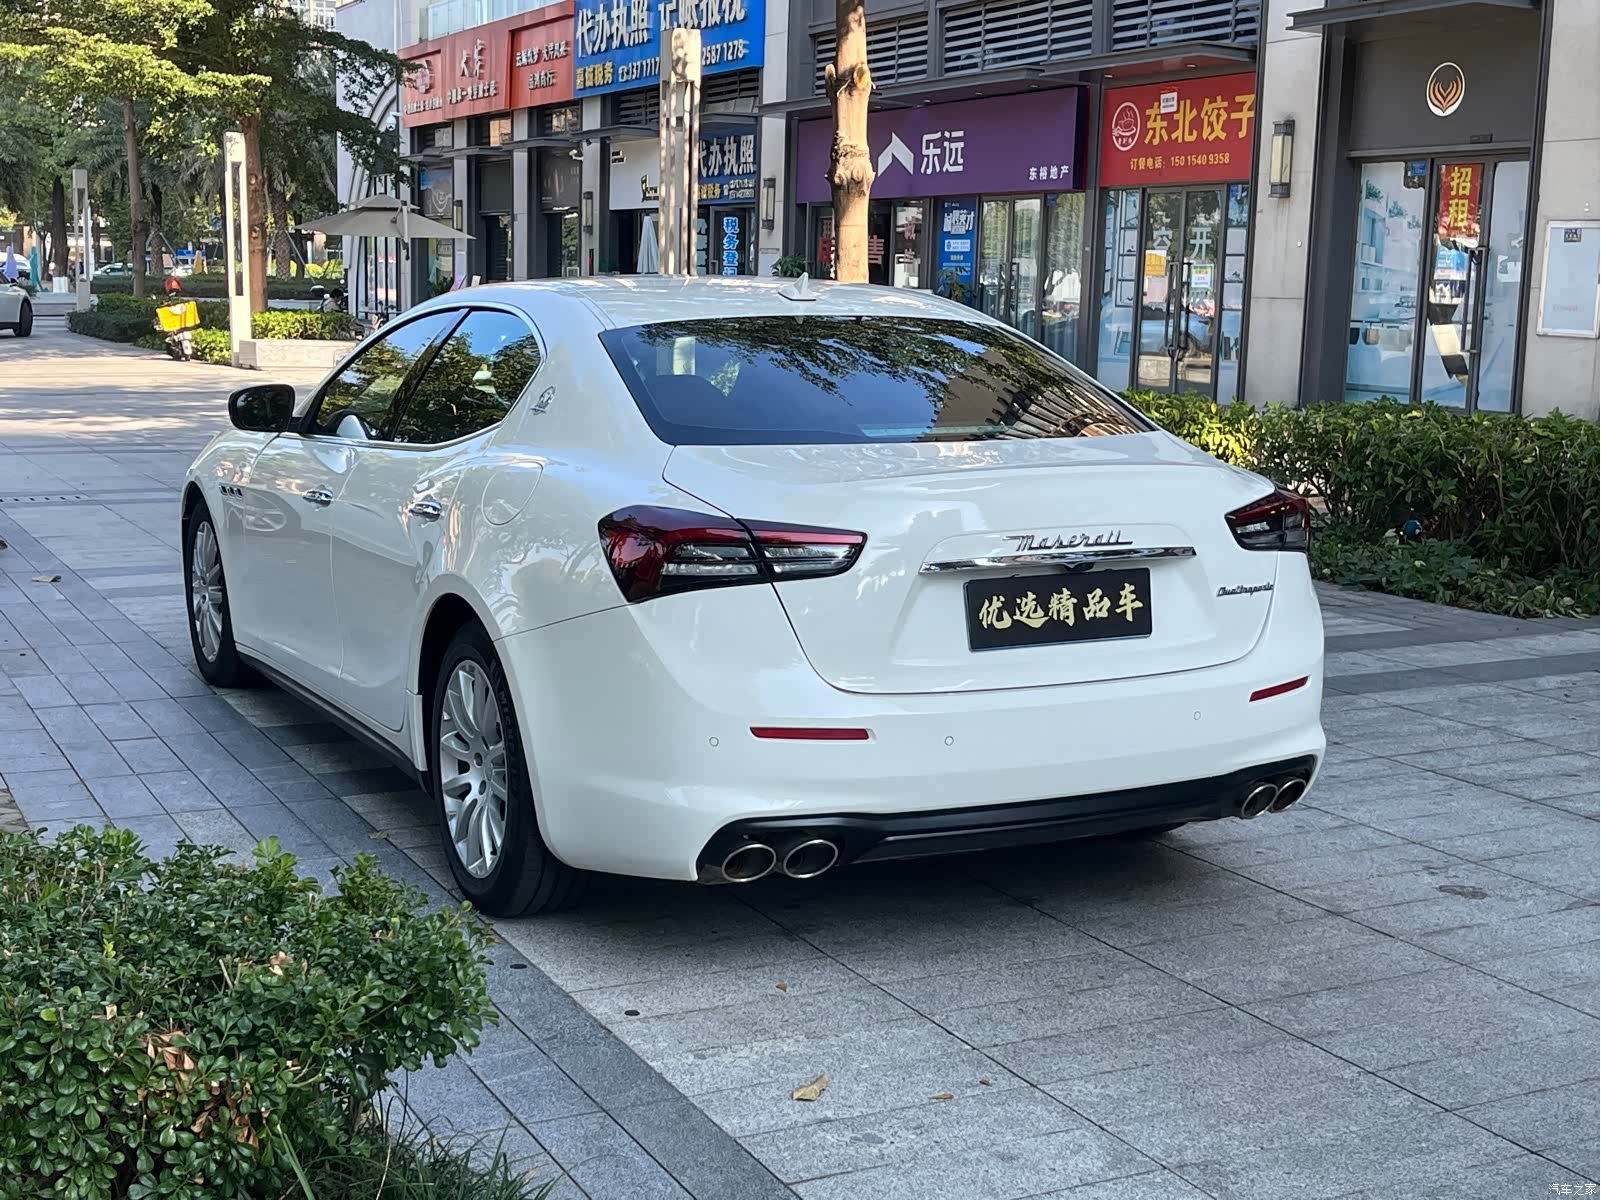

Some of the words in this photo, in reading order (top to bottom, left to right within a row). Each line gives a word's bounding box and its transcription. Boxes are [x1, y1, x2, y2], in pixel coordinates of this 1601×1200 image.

[575, 0, 649, 57] 代办执照
[723, 39, 745, 61] 1278
[1144, 94, 1255, 146] 东北饺子
[920, 131, 965, 175] 乐远
[1028, 164, 1069, 181] 东裕地产
[1170, 156, 1185, 167] 150
[1187, 154, 1207, 167] 1540
[1208, 152, 1230, 165] 9358
[1447, 166, 1472, 227] 招租
[1002, 530, 1133, 552] Maserati
[978, 582, 1144, 630] 优选精品车
